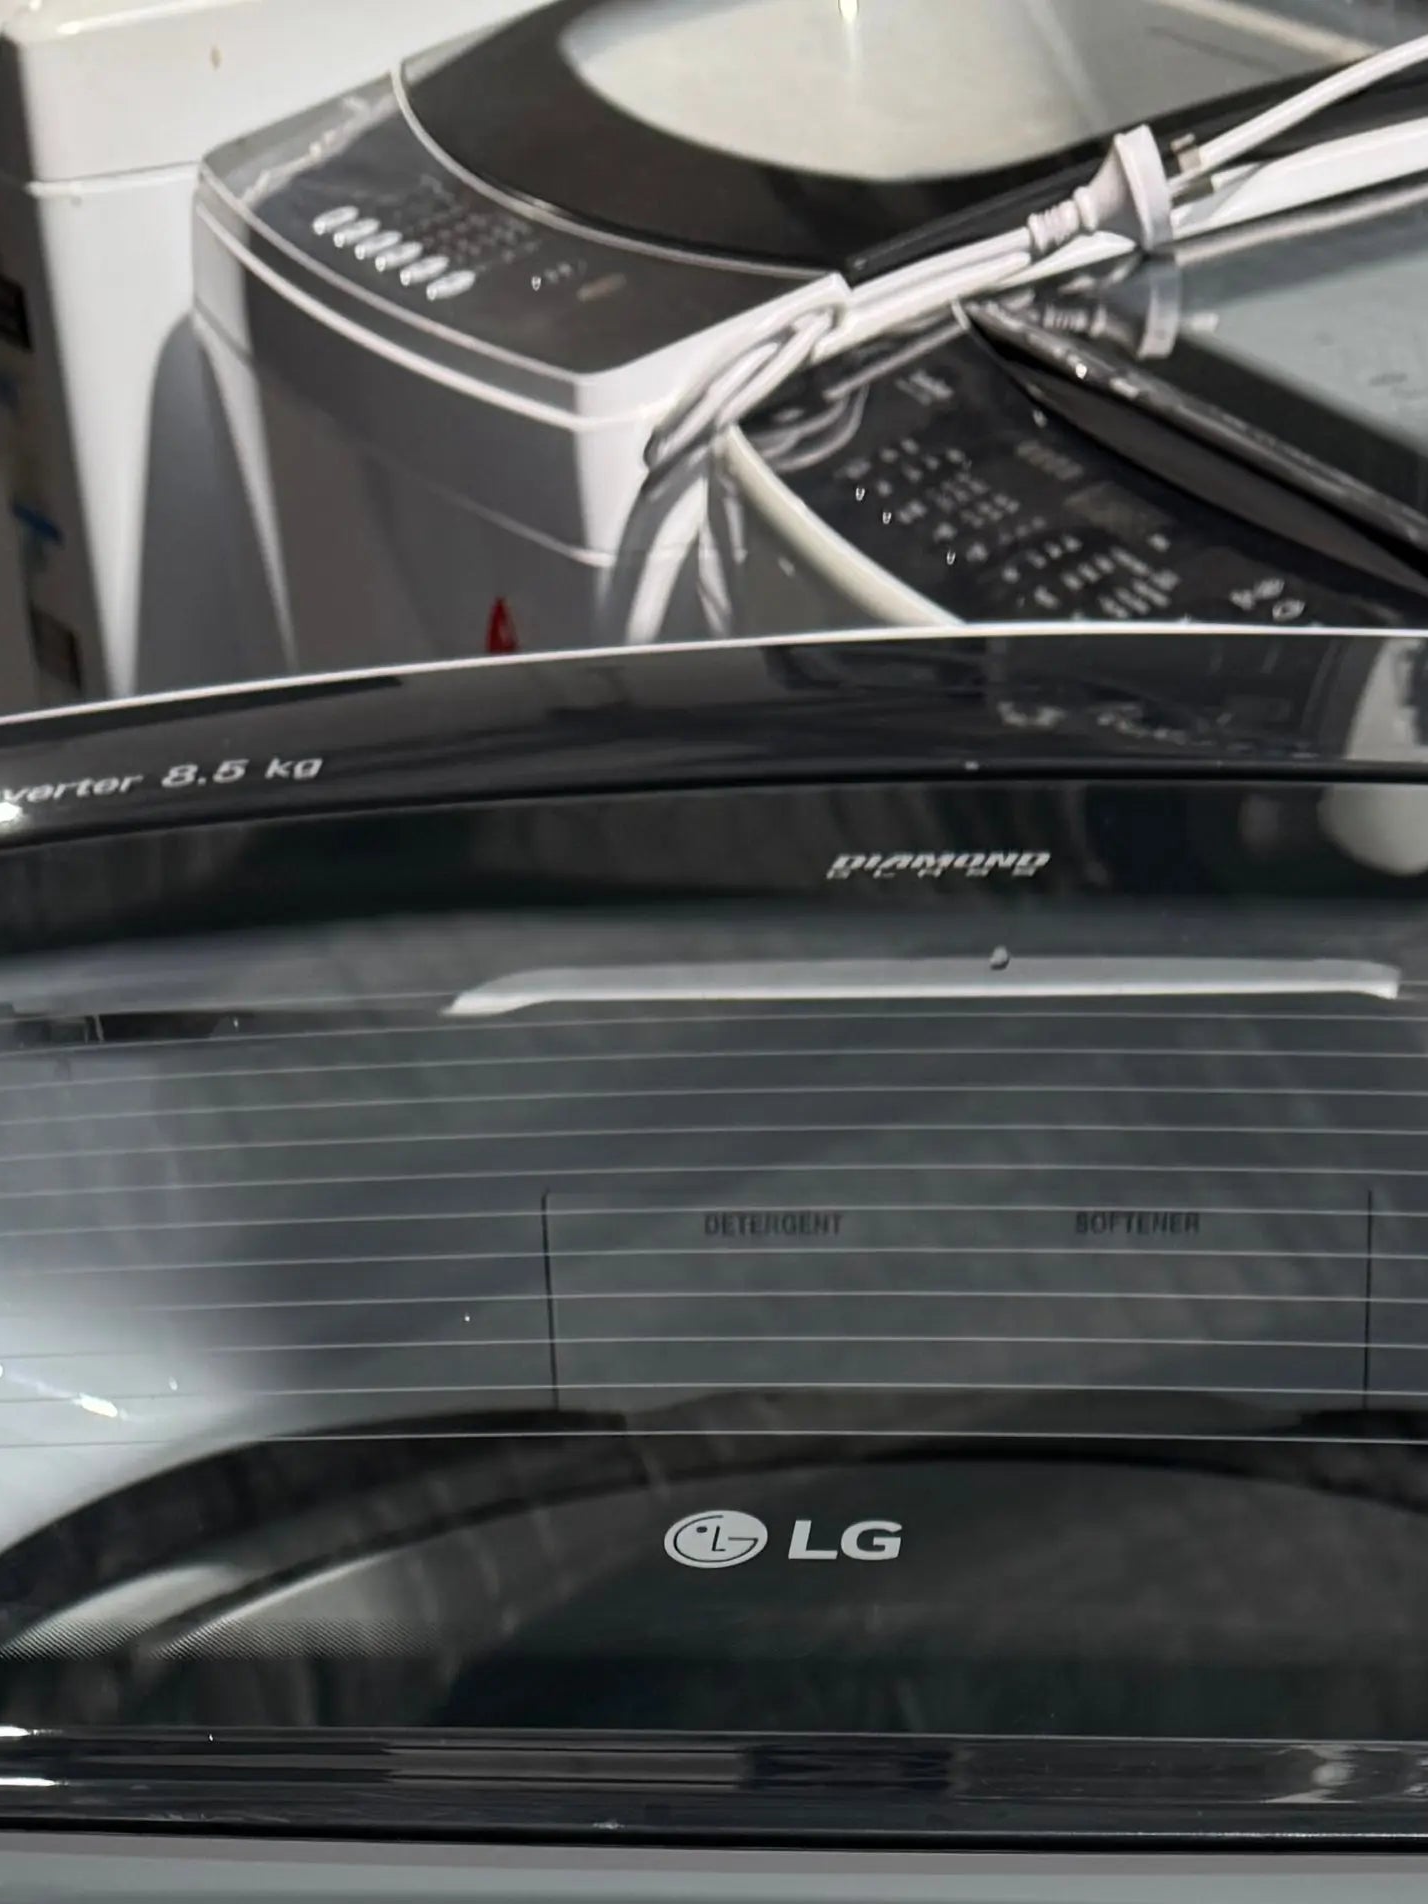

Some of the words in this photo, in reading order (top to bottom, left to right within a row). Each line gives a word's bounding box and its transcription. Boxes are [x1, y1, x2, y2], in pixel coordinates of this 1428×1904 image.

[161, 756, 249, 787] 8.5
[265, 756, 323, 779] kg
[830, 851, 1052, 870] DIAMOND
[704, 1211, 843, 1237] DETERGENT
[1075, 1211, 1202, 1236] SOFTENER
[787, 1518, 904, 1561] LG
